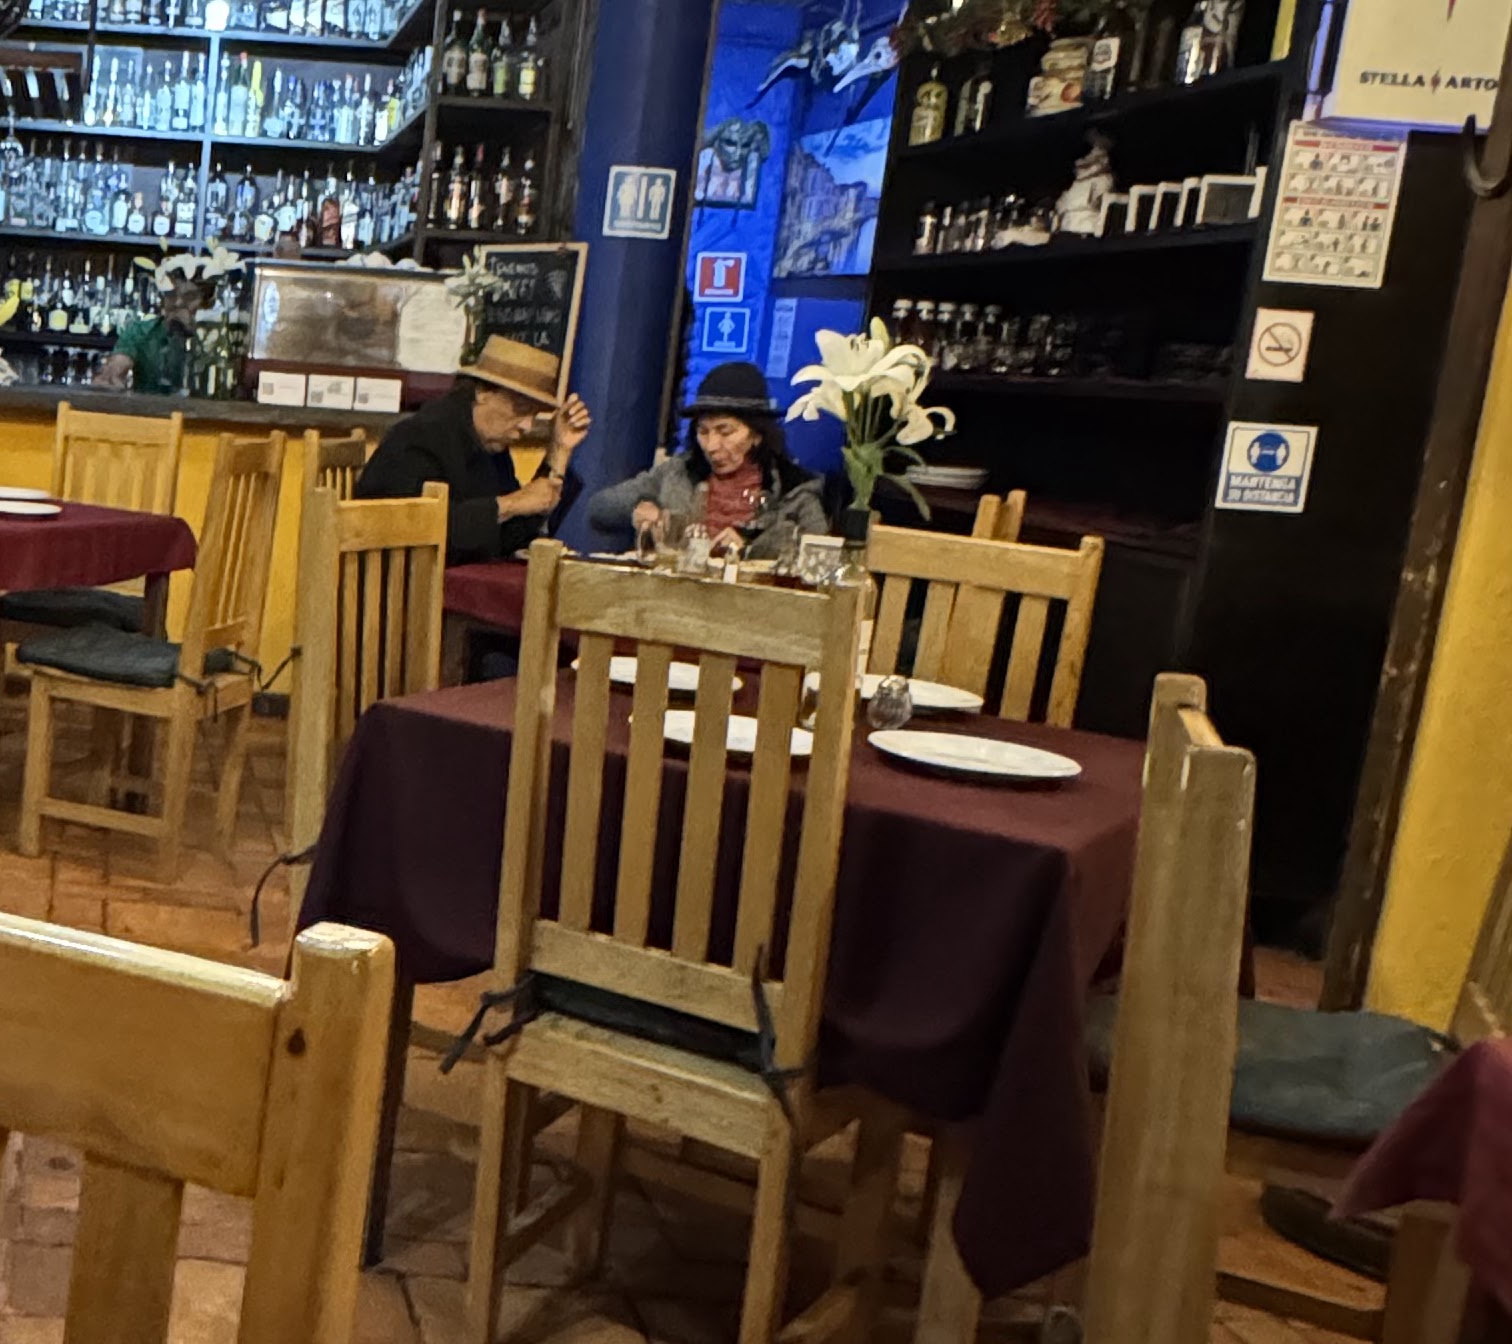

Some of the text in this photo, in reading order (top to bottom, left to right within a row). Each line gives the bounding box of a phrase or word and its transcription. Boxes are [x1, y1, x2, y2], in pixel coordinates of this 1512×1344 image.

[1359, 70, 1500, 92] STELLA ARTO
[1229, 475, 1296, 490] MANTENGA
